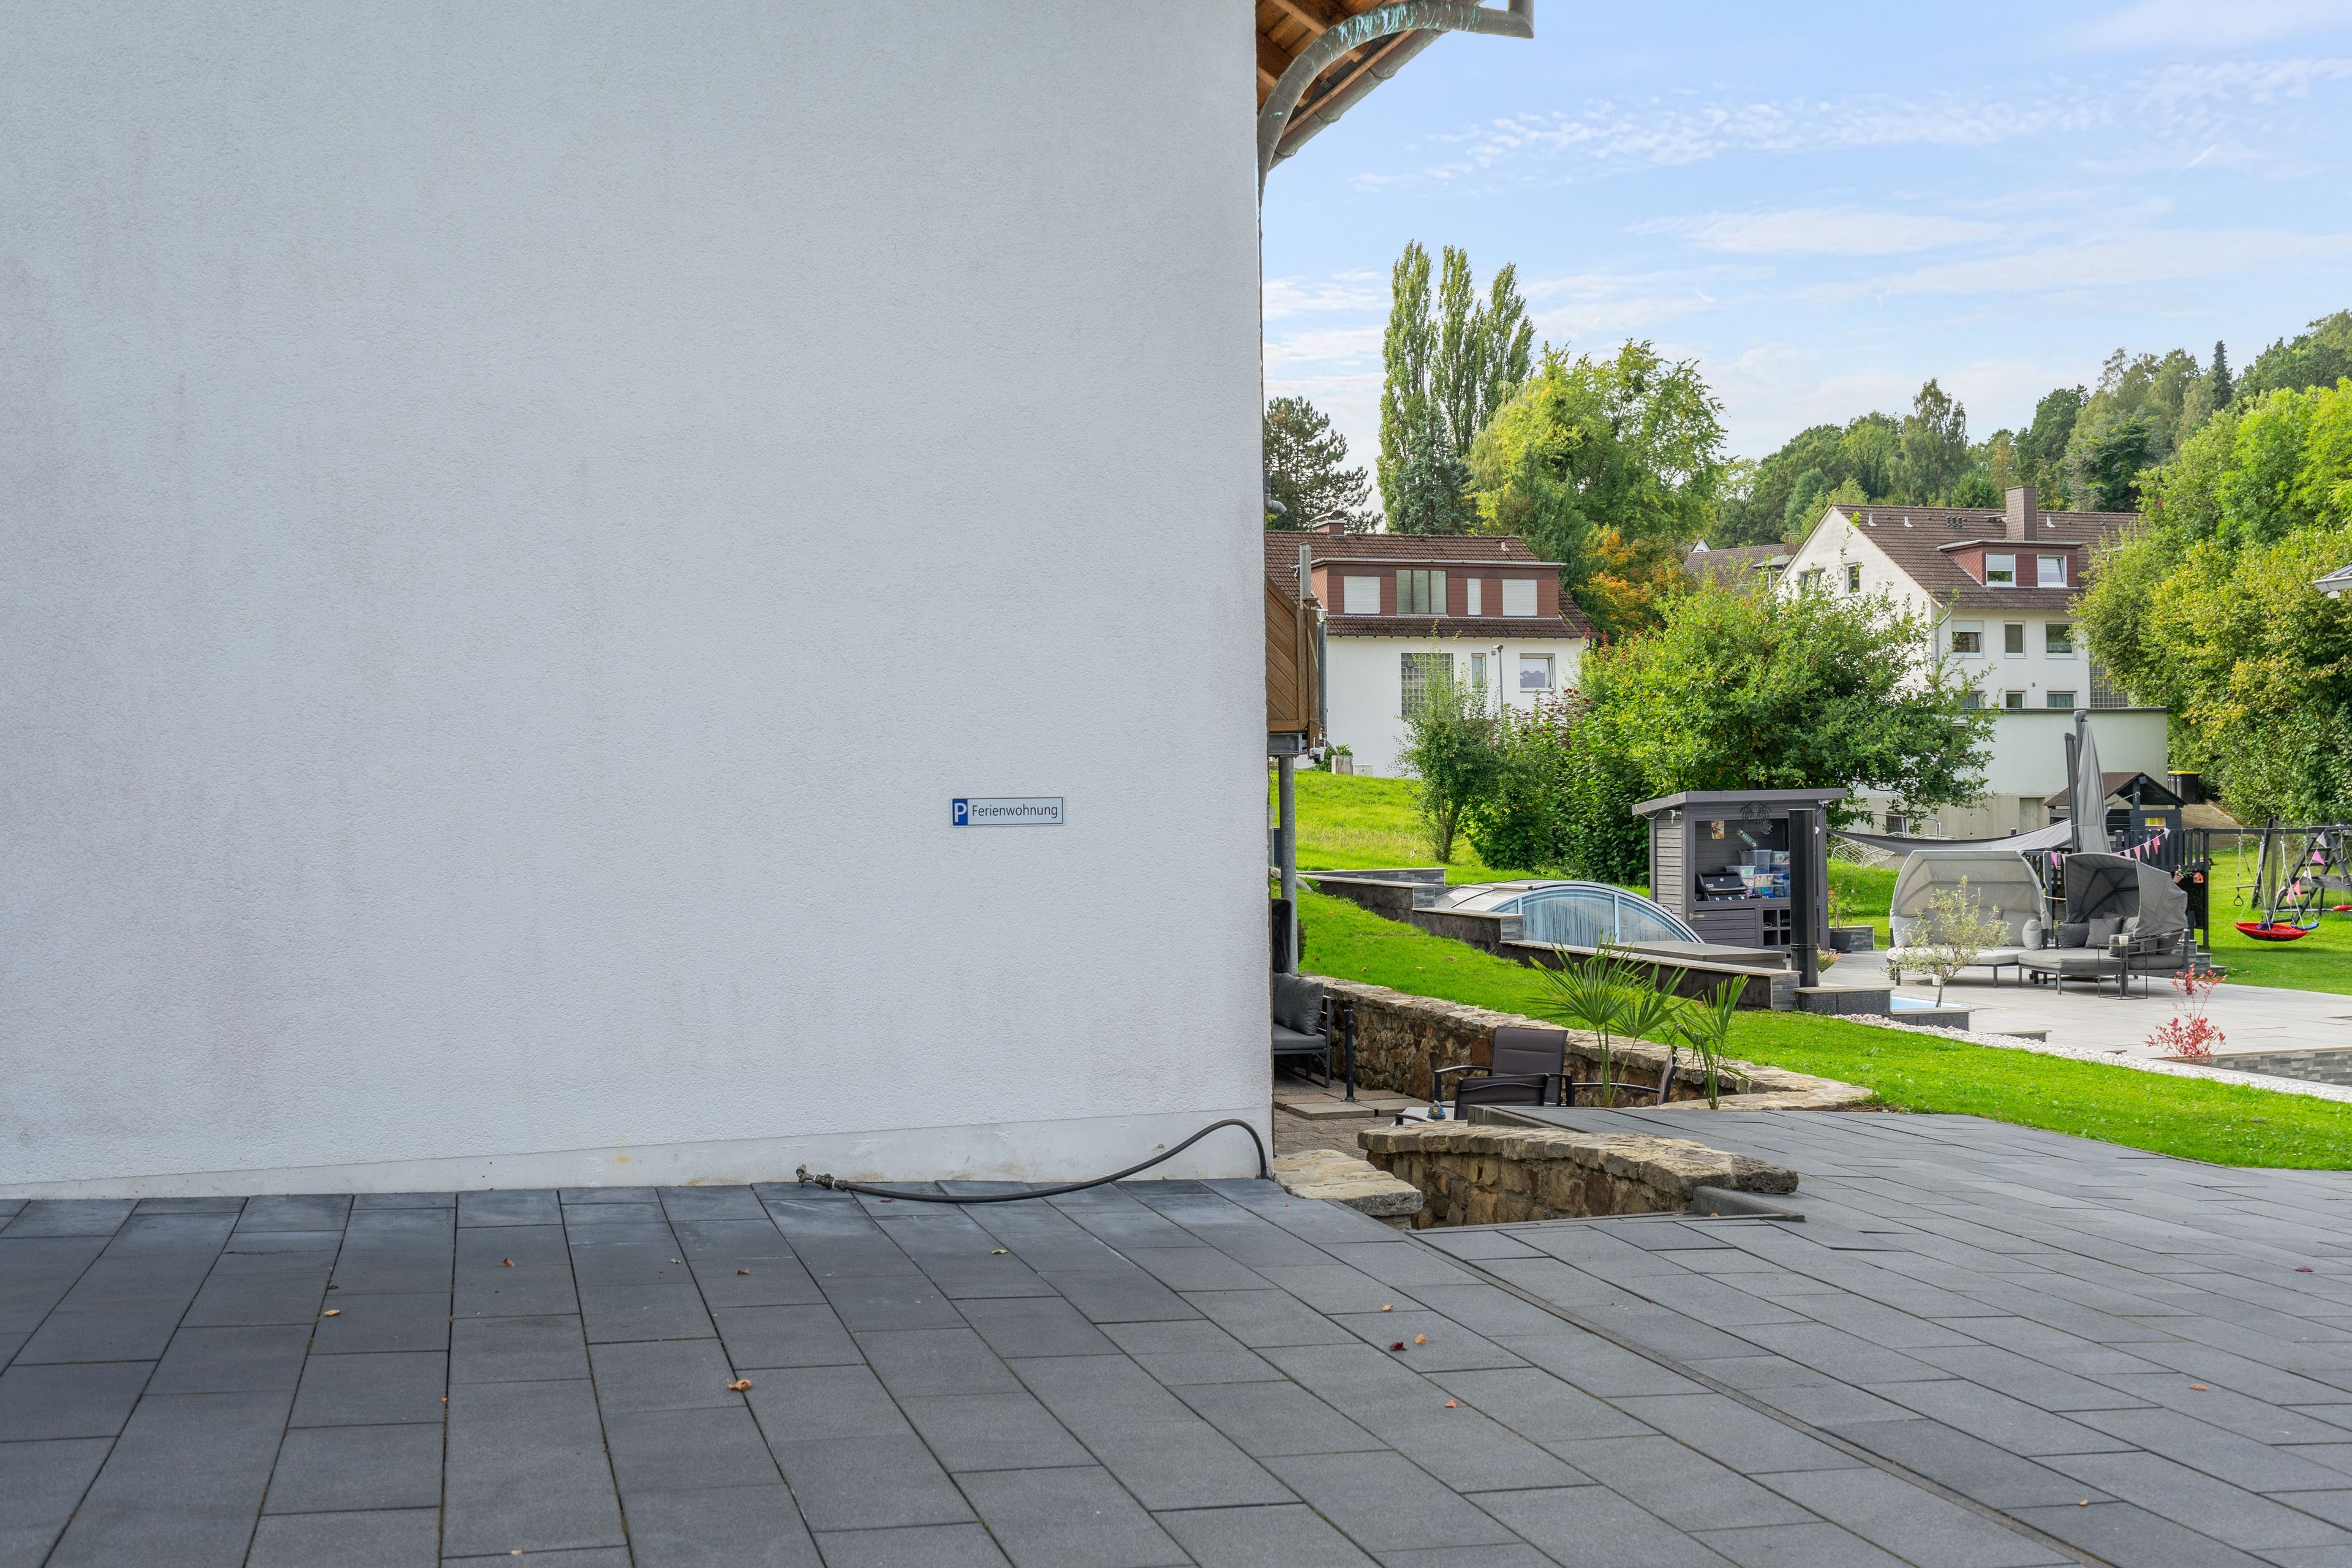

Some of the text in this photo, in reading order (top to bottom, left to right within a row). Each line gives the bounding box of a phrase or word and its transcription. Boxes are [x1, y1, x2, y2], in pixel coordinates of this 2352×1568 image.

[954, 802, 1058, 823] P Ferienwohnung
[1741, 833, 1752, 843] BEER
